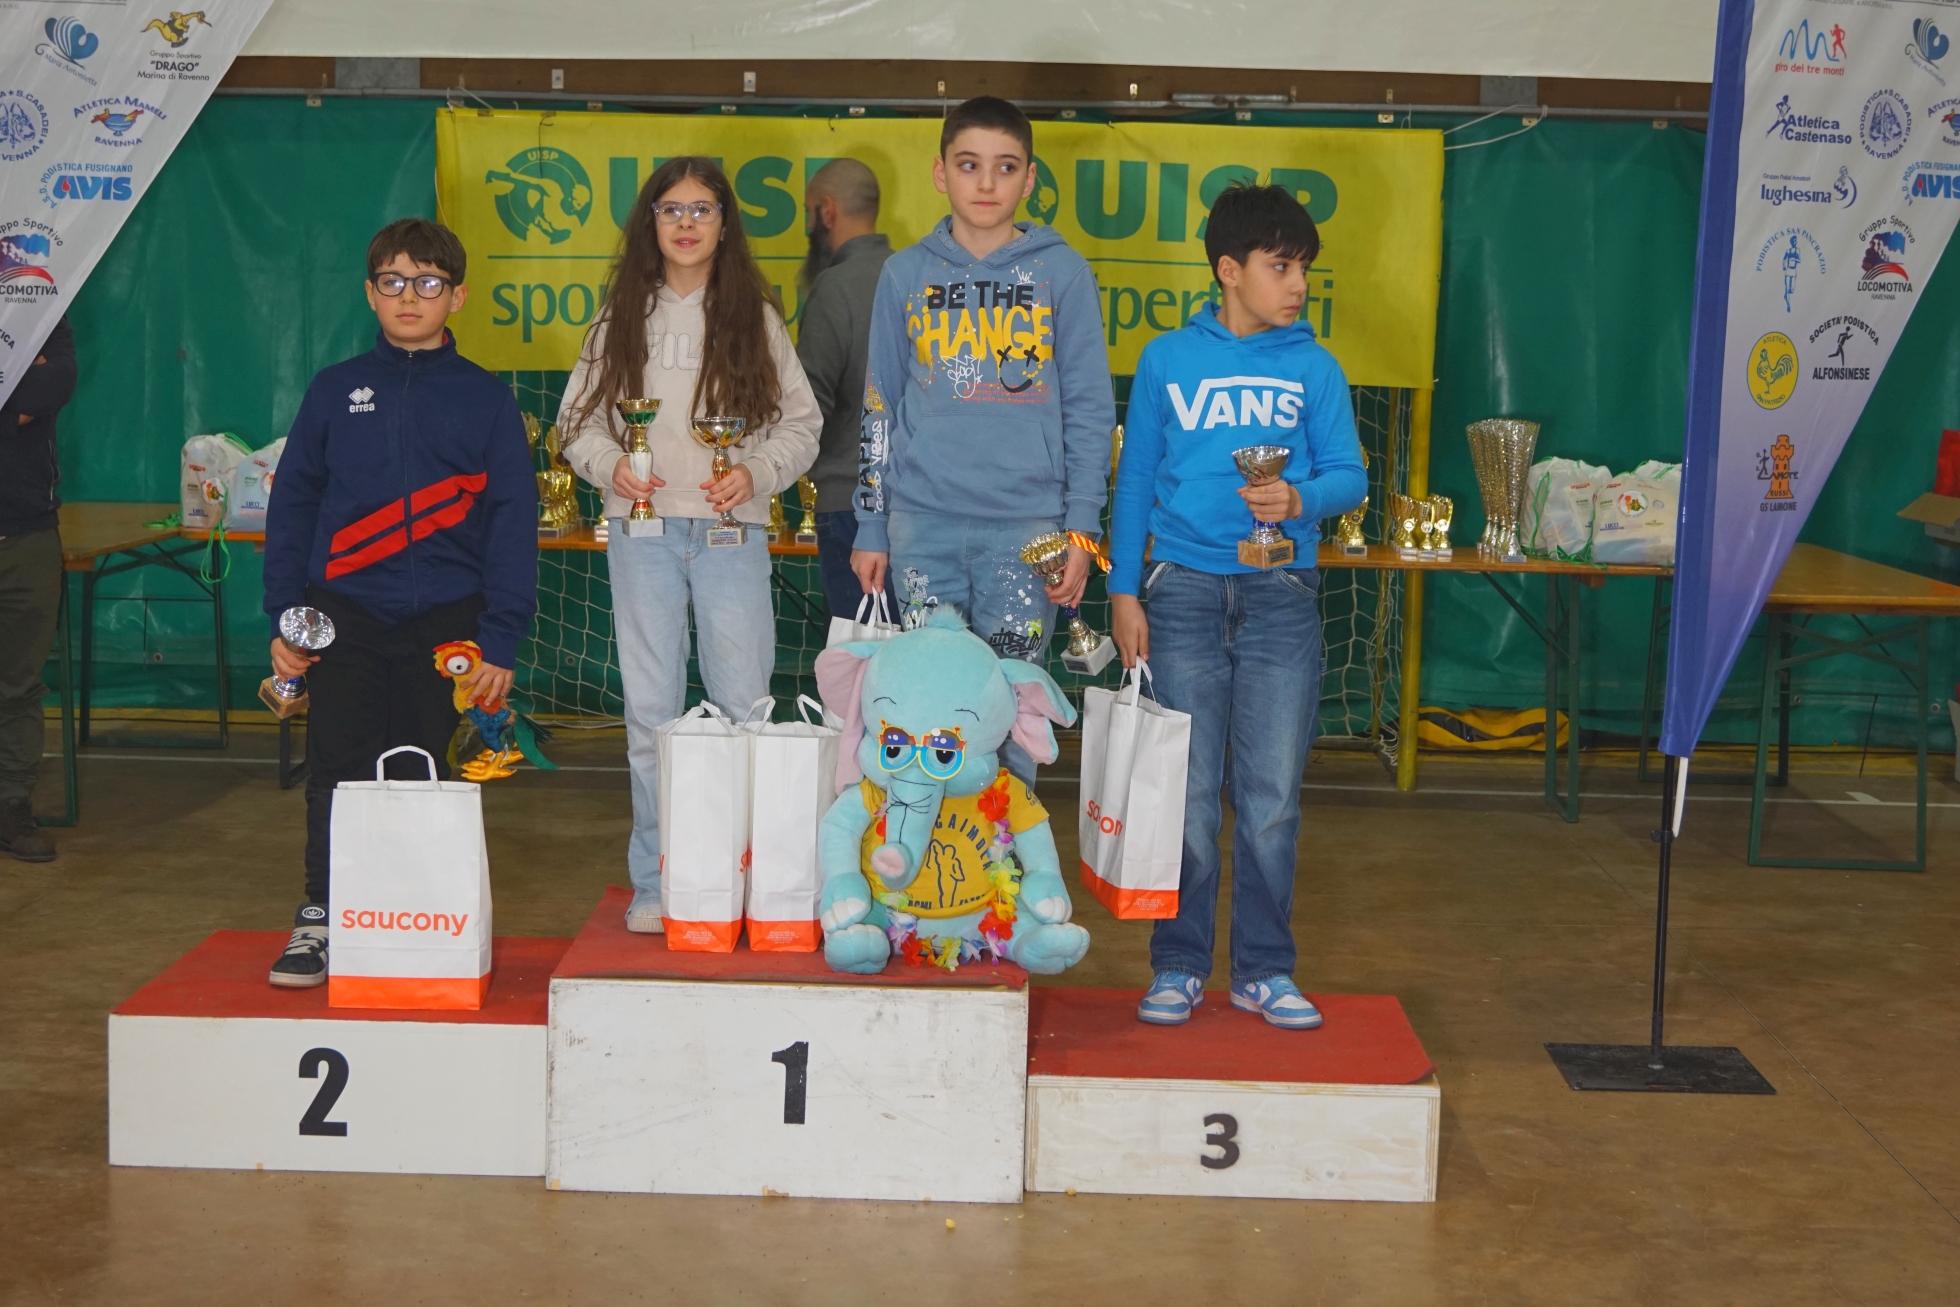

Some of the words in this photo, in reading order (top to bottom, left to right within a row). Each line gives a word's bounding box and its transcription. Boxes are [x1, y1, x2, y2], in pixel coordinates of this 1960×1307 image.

[150, 50, 175, 58] Gruppo
[176, 52, 202, 60] Sportivo
[137, 71, 166, 80] Marina
[169, 72, 176, 80] di
[178, 73, 210, 81] Ravenna
[1775, 62, 1789, 74] giro
[1791, 63, 1804, 73] dei
[1807, 65, 1820, 74] tre
[1823, 66, 1845, 76] monti
[73, 98, 121, 118] ATLETICA
[1860, 89, 1884, 138] PODISTICA
[1927, 98, 1960, 118] ATLETIC
[1787, 114, 1840, 130] Atletica
[95, 136, 142, 147] RAVENNA
[1784, 128, 1852, 144] Castenaso
[1, 145, 40, 161] VENNA
[527, 150, 559, 161] UISP
[1864, 144, 1904, 159] RAVENNA
[41, 162, 83, 184] PODISTICA
[85, 163, 133, 173] FUSIGNANO
[53, 175, 133, 201] AVIS
[22, 217, 64, 247] Sportivo
[1859, 217, 1887, 242] Gruppo
[1889, 214, 1915, 244] Sportivo
[1756, 230, 1785, 272] PODISTICA
[1786, 227, 1801, 235] SAN
[1801, 229, 1827, 275] PANCRAZIO
[927, 282, 966, 310] BE
[974, 280, 1035, 311] THE
[1857, 281, 1913, 293] LOCOMOTIVA
[5, 296, 37, 304] RAVENNA
[907, 305, 1054, 367] CHANGE
[1843, 315, 1880, 346] PODISTICA
[1812, 367, 1871, 380] ALFONSINESE
[1166, 376, 1305, 431] VANS
[1760, 503, 1768, 512] GS
[1770, 502, 1797, 512] LAMONE
[341, 909, 468, 937] saucony
[299, 1047, 350, 1137] 2
[771, 1041, 809, 1125] 1
[1200, 1112, 1240, 1170] 3
